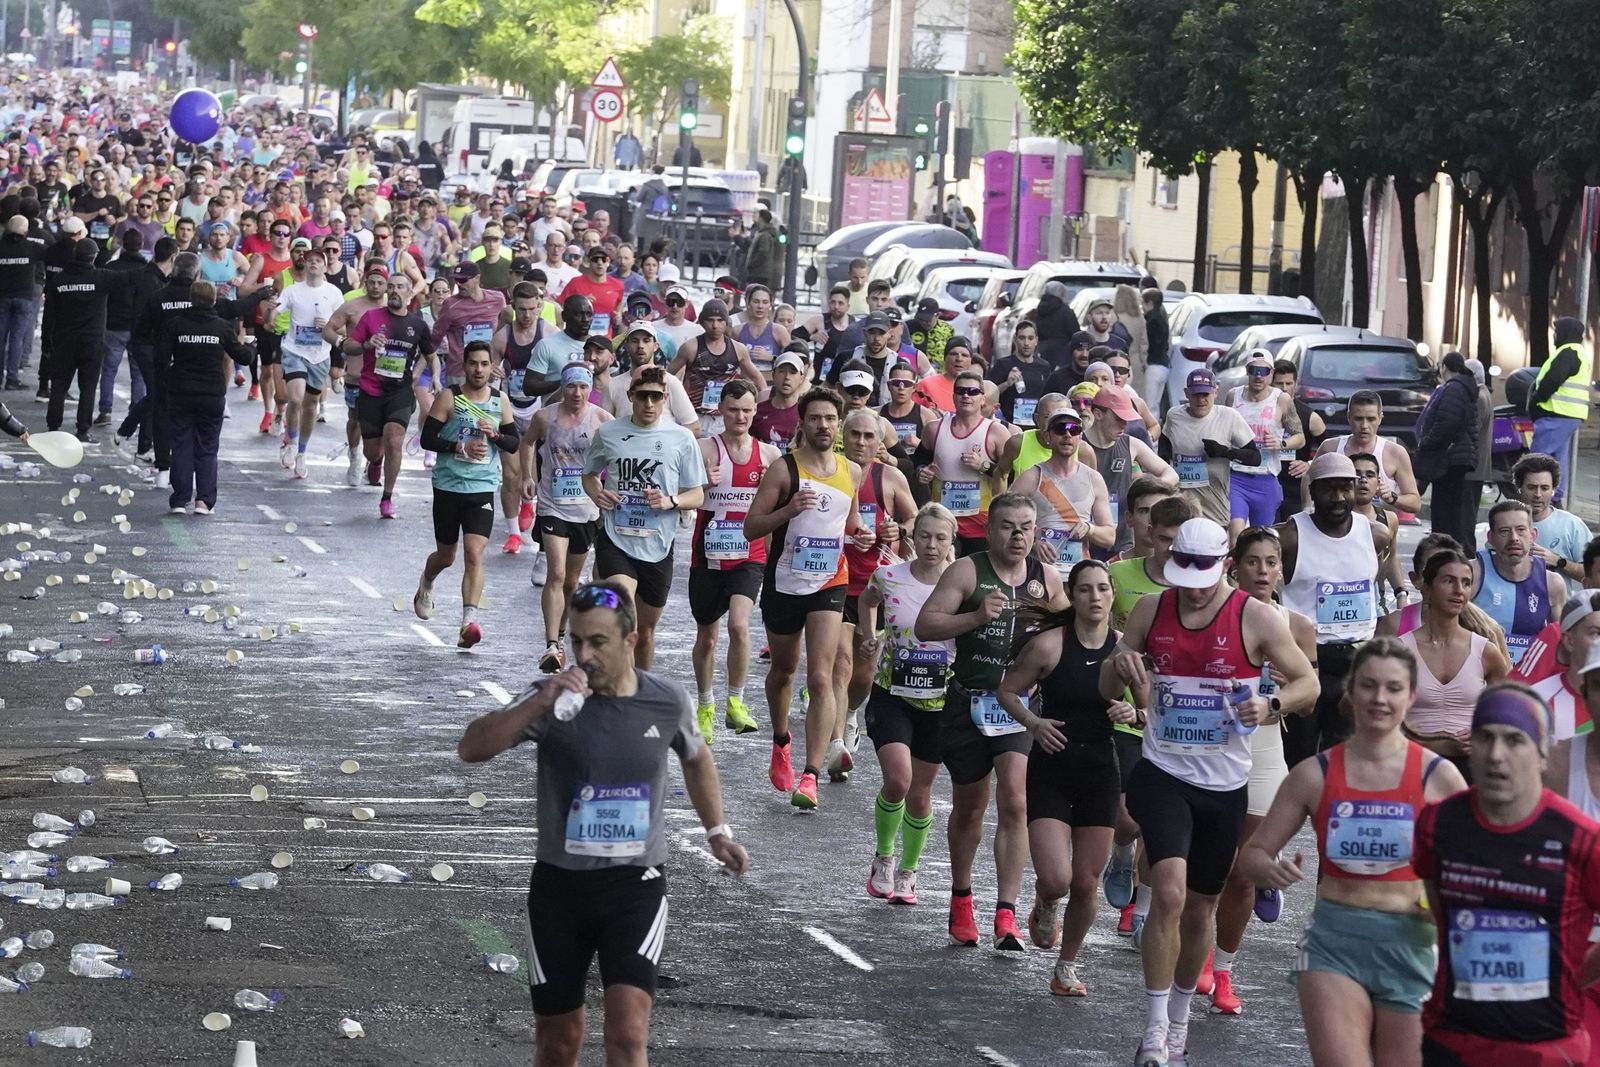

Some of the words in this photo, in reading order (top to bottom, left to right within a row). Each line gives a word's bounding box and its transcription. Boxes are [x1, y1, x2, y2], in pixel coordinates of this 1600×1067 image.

[598, 99, 617, 111] 30
[57, 283, 95, 293] VOLUNTEER
[178, 335, 219, 345] VOLUNTEER
[1495, 436, 1512, 445] cabify
[1182, 455, 1202, 463] ZURICH
[1179, 473, 1201, 481] GALLO
[953, 482, 977, 490] ZURICH
[562, 487, 582, 496] PATO
[951, 500, 971, 509] TONÉ
[628, 518, 645, 527] EDU
[705, 541, 749, 550] CHRISTIAN
[811, 539, 837, 547] ZURICH
[804, 560, 828, 570] FELIX
[1336, 583, 1365, 593] ZURICH
[1338, 600, 1353, 608] 5621
[1333, 609, 1358, 621] ALEX
[983, 628, 1006, 637] JOSE
[912, 651, 941, 660] ZURICH
[911, 667, 928, 675] 5025
[904, 676, 933, 688] LUCIE
[1259, 683, 1275, 694] CE
[1176, 698, 1215, 707] ZURICH
[984, 712, 1014, 724] ELIAS
[1177, 716, 1198, 725] 6360
[1163, 727, 1215, 741] ANTOINE
[597, 786, 641, 798] ZURICH
[596, 808, 620, 819] 5592
[1357, 802, 1405, 817] ZURICH
[578, 823, 636, 839] LUISMA
[1339, 838, 1400, 858] SOLÈNE
[1480, 914, 1537, 930] ZURICH
[1470, 960, 1525, 979] TXABI
